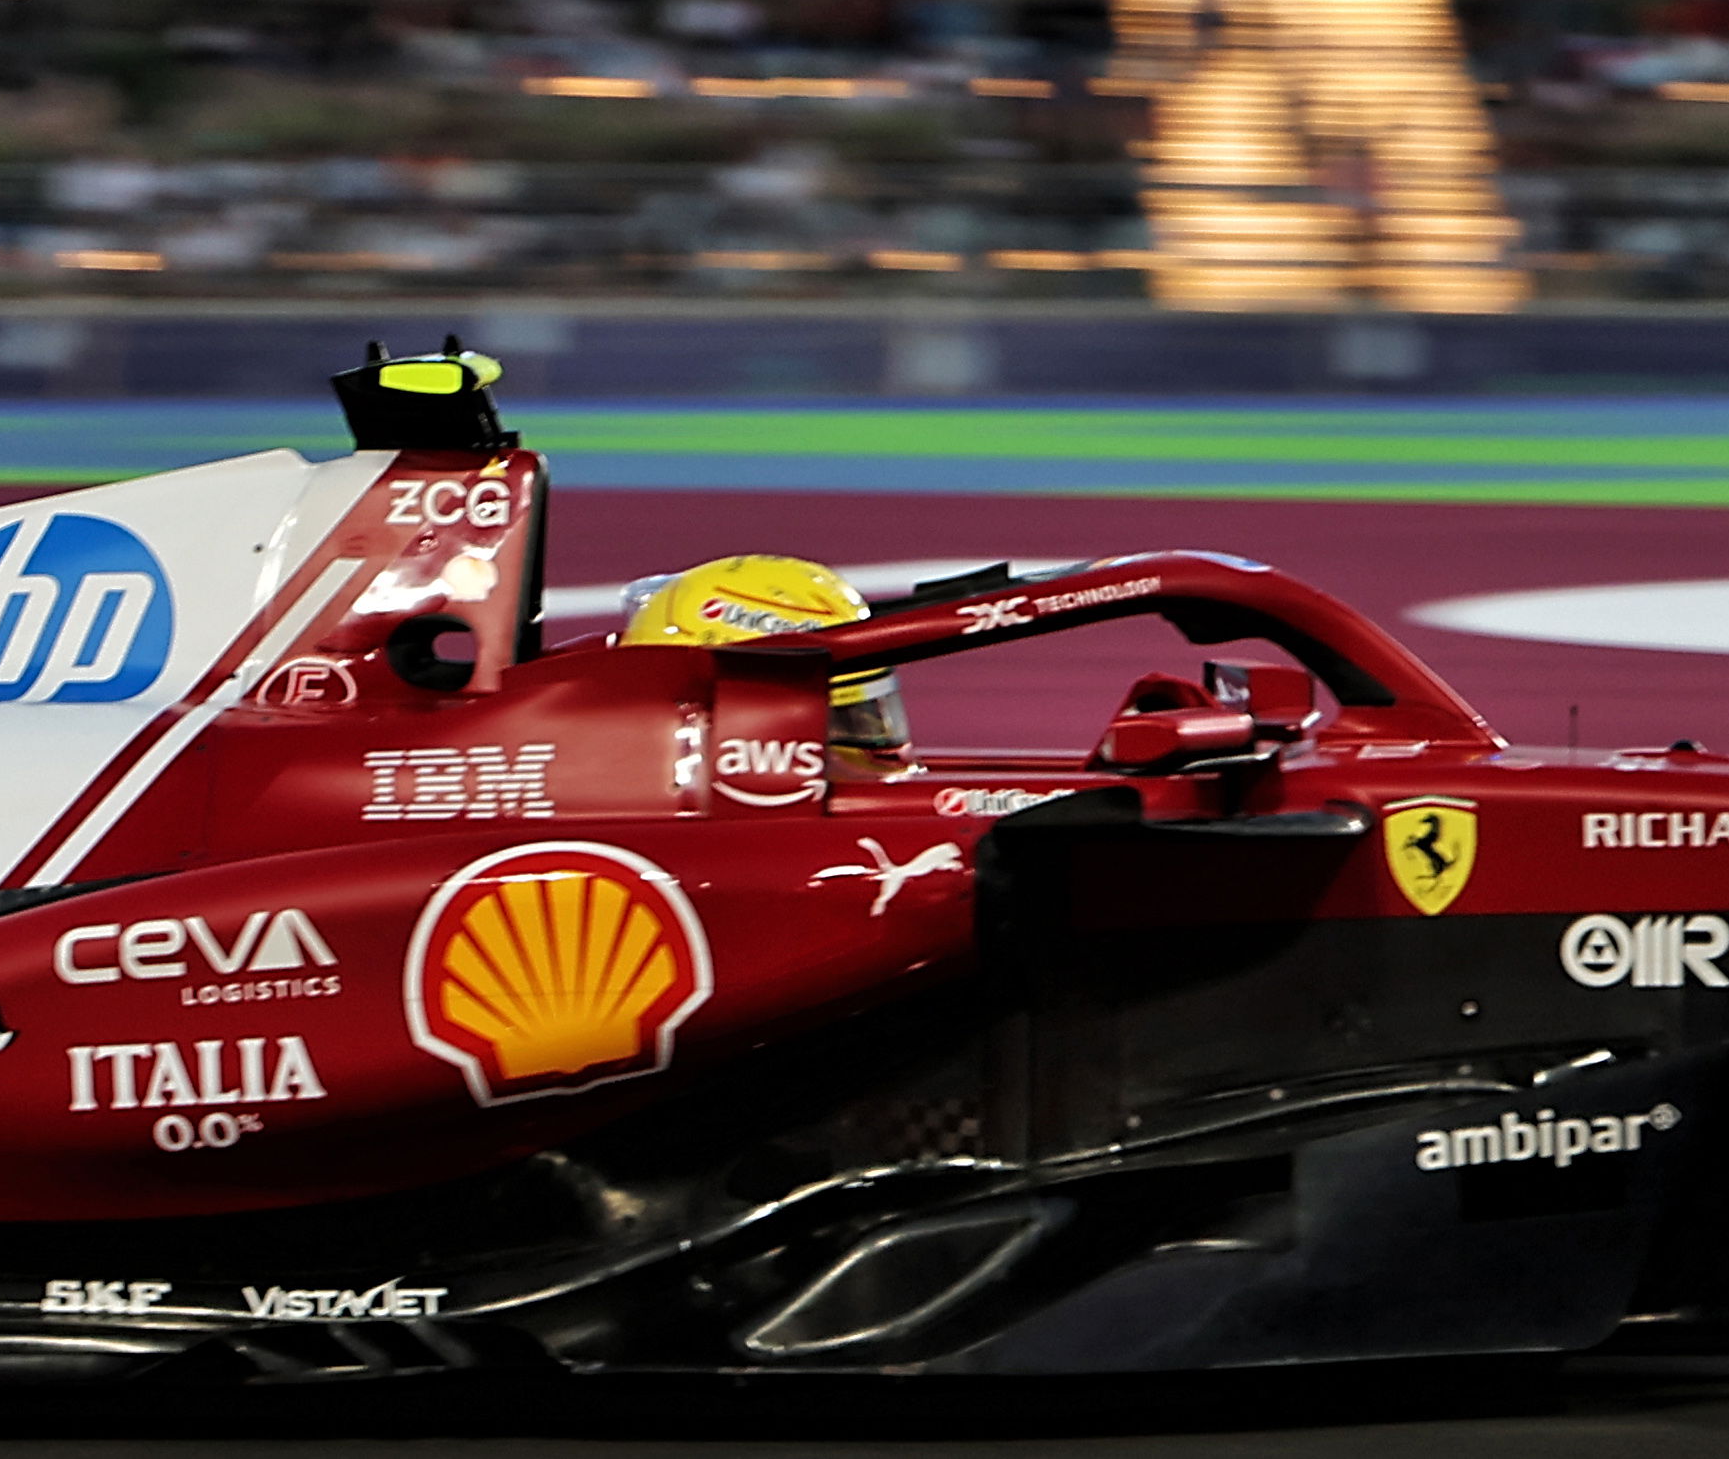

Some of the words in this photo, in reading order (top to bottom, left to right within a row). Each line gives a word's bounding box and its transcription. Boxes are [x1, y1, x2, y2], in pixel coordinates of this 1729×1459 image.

[384, 479, 511, 528] ZCG
[715, 738, 825, 778] aws
[361, 743, 556, 820] IBM
[180, 975, 342, 1006] LOGISTICS
[66, 1036, 329, 1110] ITALIA
[39, 1280, 172, 1314] SKF
